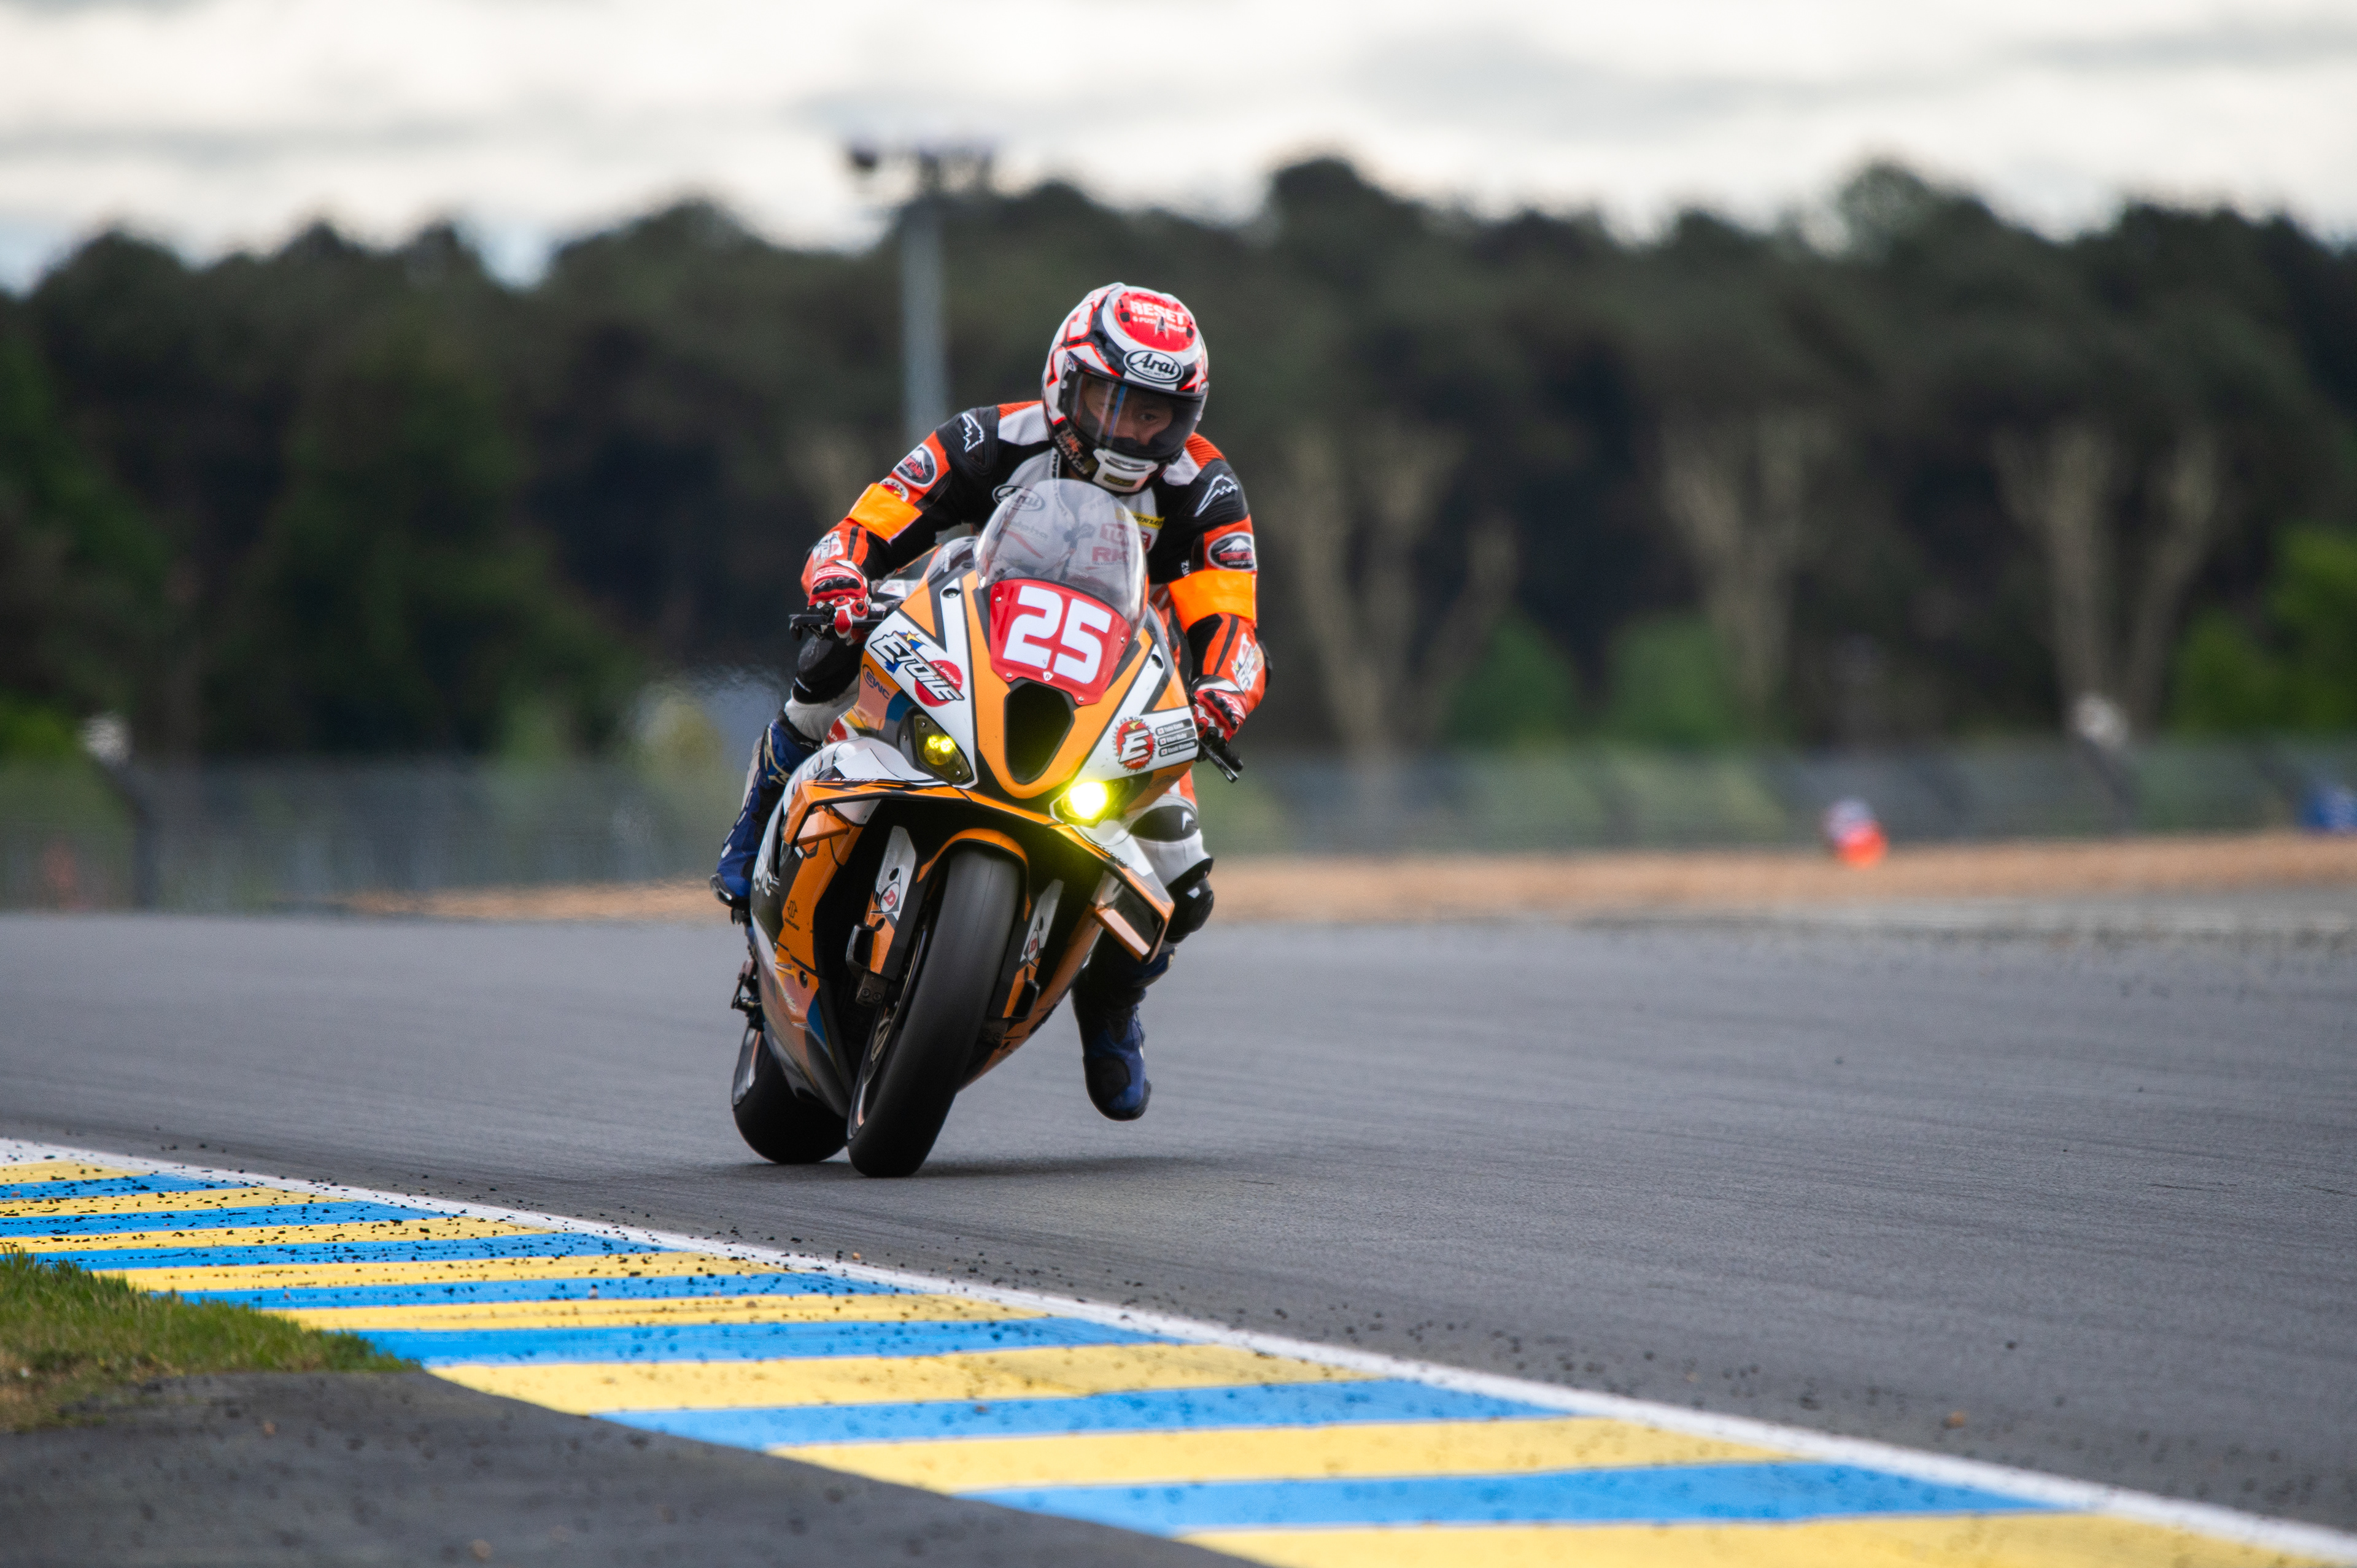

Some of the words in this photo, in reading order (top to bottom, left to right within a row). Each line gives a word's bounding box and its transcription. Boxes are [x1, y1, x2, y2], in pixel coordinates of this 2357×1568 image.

[1129, 300, 1186, 325] RESET
[1129, 353, 1177, 376] Arai
[1003, 585, 1112, 684] 25
[865, 670, 890, 700] EWC
[934, 662, 961, 686] JAPON
